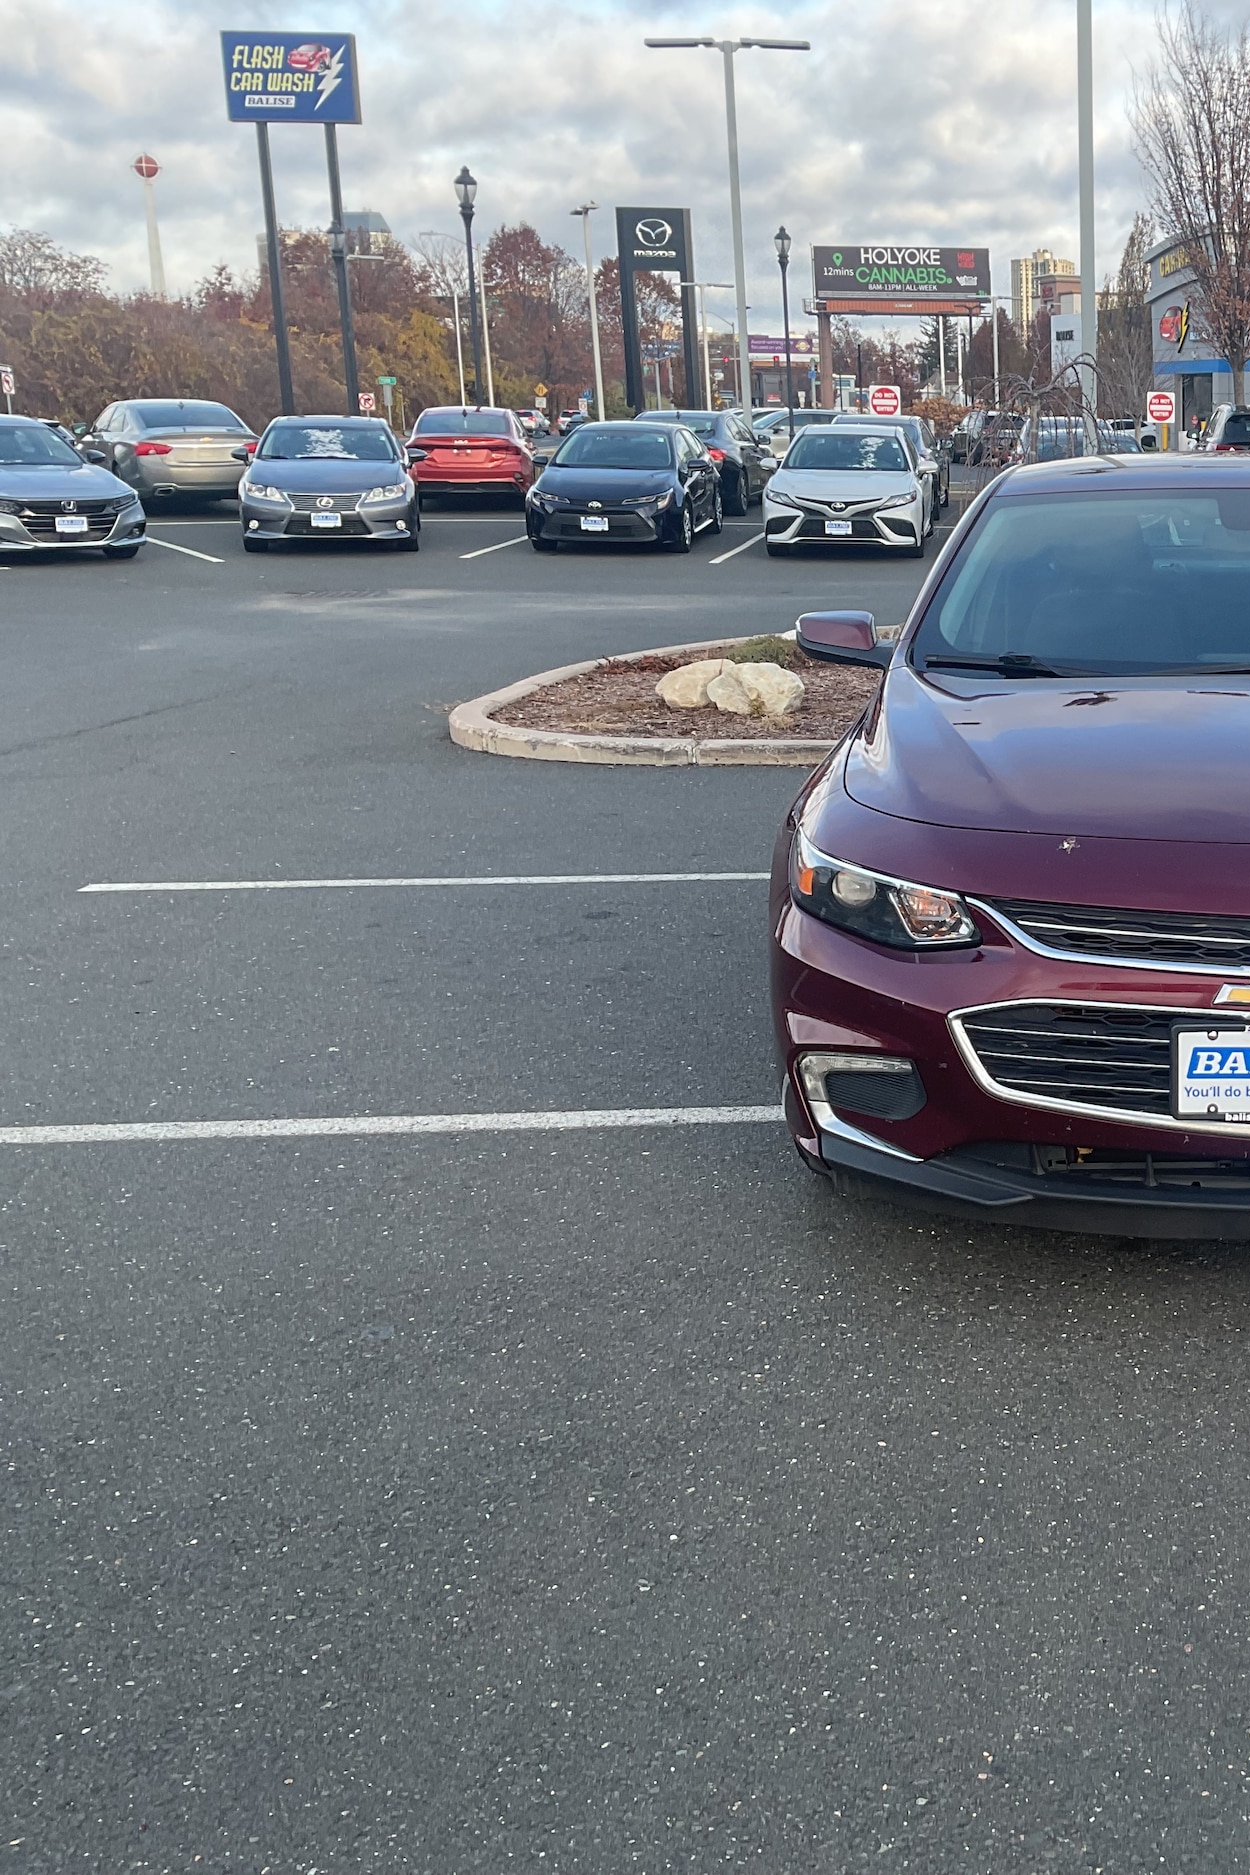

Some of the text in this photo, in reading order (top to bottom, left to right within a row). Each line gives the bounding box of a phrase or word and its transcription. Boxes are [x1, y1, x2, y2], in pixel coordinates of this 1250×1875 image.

[232, 45, 285, 69] FLASH
[230, 72, 315, 92] CAR WASH
[247, 97, 294, 106] BALISE
[860, 248, 941, 265] HOLYOKE
[823, 267, 854, 276] 12mins
[1184, 1087, 1220, 1098] You'll
[1224, 1087, 1241, 1098] do
